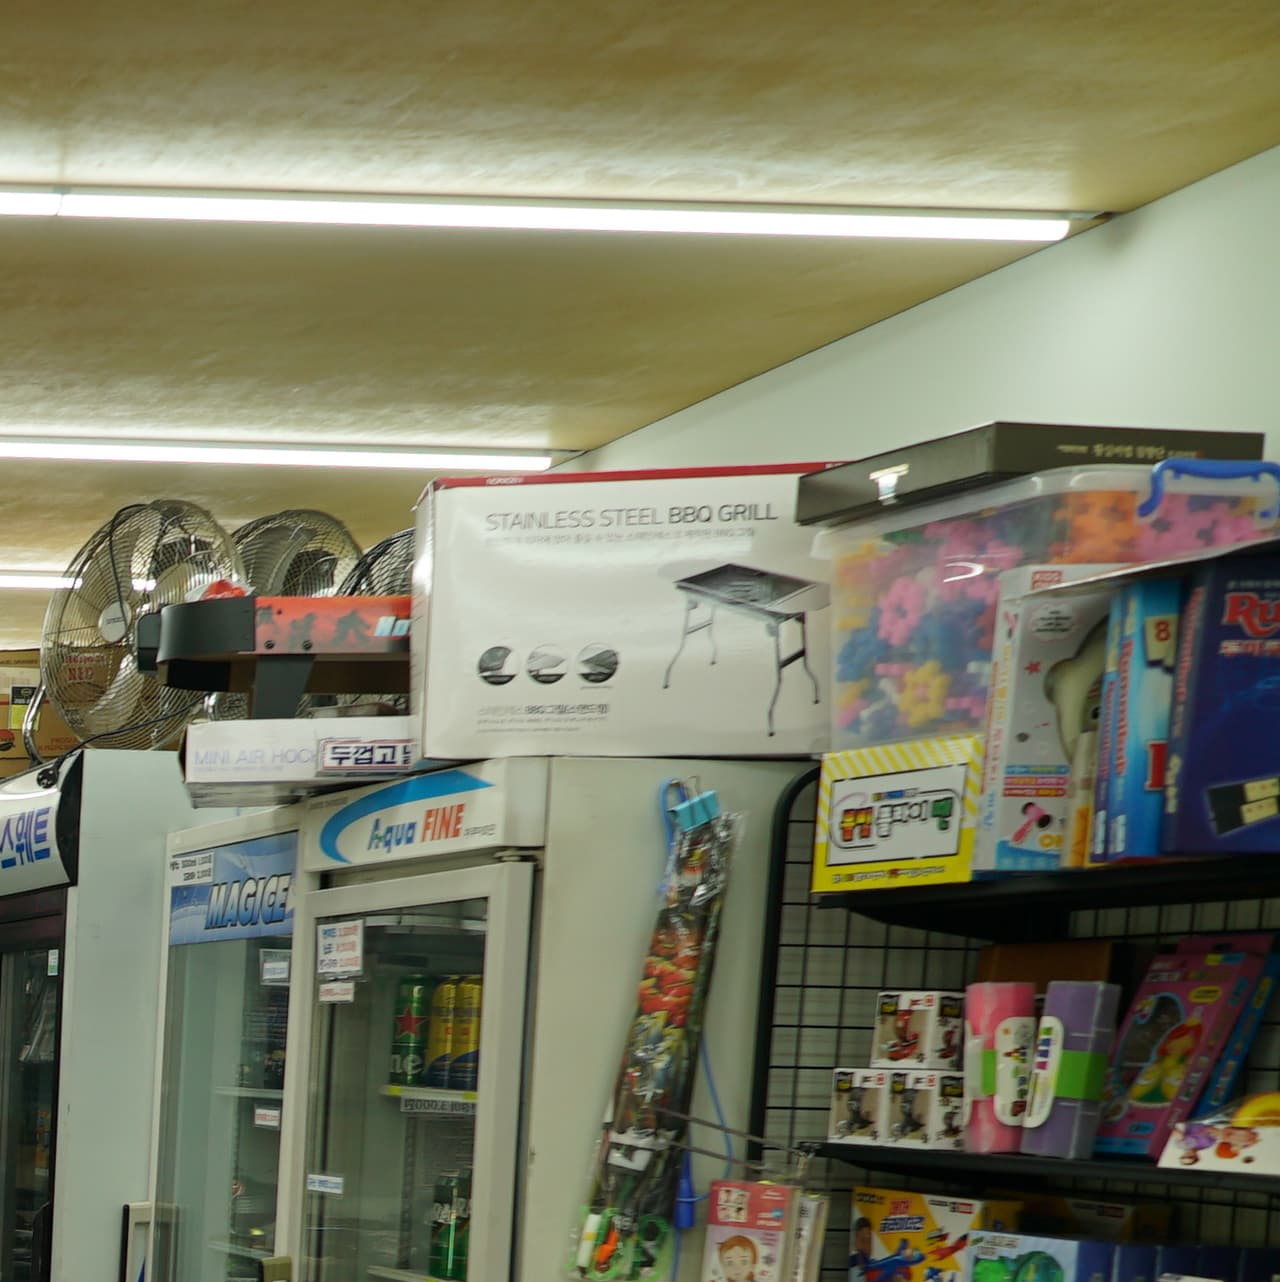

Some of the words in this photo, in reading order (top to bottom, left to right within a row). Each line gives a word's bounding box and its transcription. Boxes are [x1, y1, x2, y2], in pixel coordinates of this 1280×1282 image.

[485, 508, 596, 531] STAINLESS
[599, 506, 660, 528] STEEL
[669, 504, 713, 524] BBQ
[719, 502, 778, 522] GRILL
[331, 745, 397, 765] 두껍고
[0, 806, 51, 869] 스웨트
[367, 817, 417, 852] Aqua
[420, 803, 465, 842] FINE
